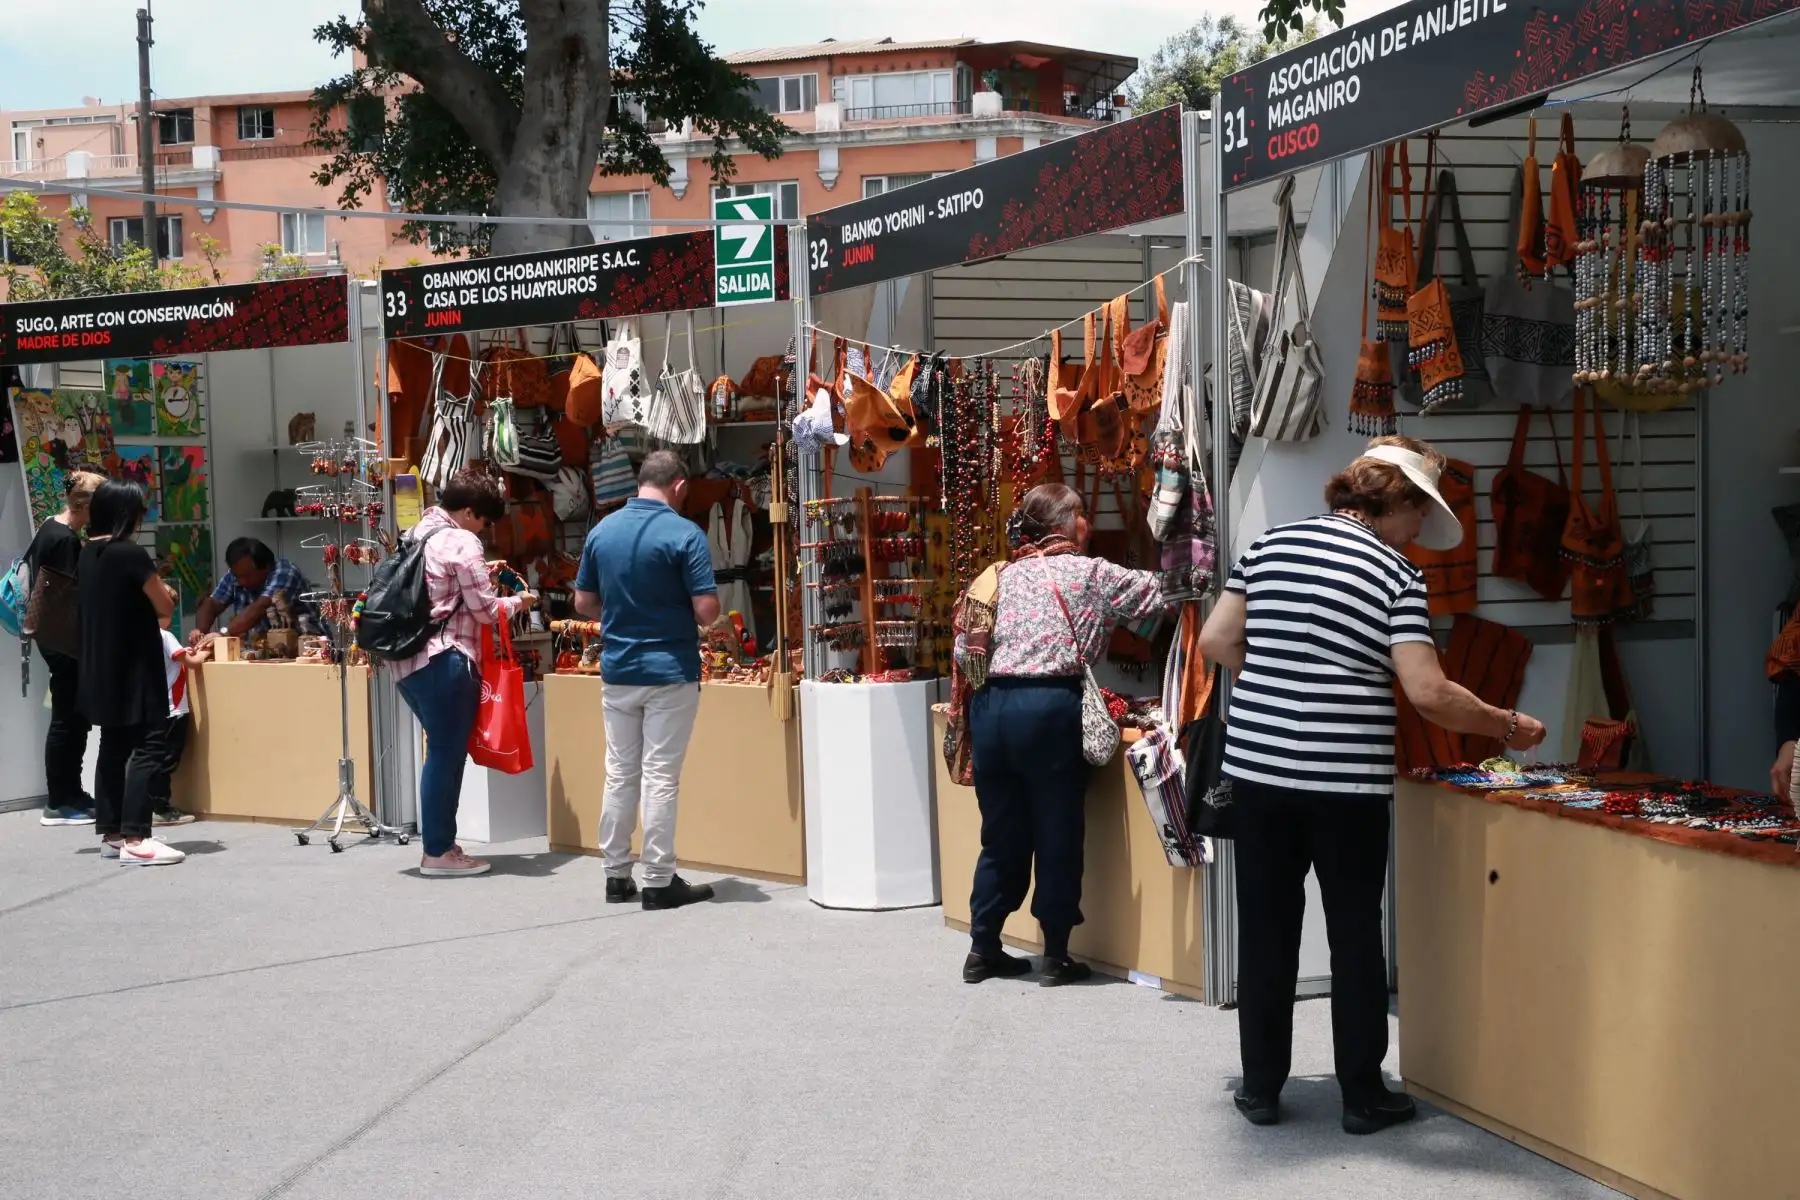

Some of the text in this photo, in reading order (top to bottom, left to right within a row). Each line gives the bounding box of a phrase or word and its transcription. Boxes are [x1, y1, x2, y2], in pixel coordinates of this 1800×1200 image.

[1267, 29, 1375, 99] ASOCIACIÓN
[1380, 20, 1408, 57] DE
[1268, 74, 1361, 131] MAGANIRO
[1223, 105, 1250, 153] 31
[1267, 122, 1320, 160] CUSCO
[841, 216, 883, 245] IBANKO
[884, 203, 925, 234] YORINI
[937, 187, 985, 220] SATIPO
[422, 249, 641, 290] OBANKOKI CHOBANKIRIPE S.A.C.
[810, 237, 829, 271] 32
[842, 240, 874, 267] JUNÍN
[423, 274, 598, 309] CASA DE LOS HUAYRUROS
[718, 272, 772, 295] SALIDA
[16, 298, 235, 334] SUGO, ARTE CON CONSERVACIÓN
[386, 290, 407, 318] 33
[17, 331, 111, 350] MADRE DE DIOS
